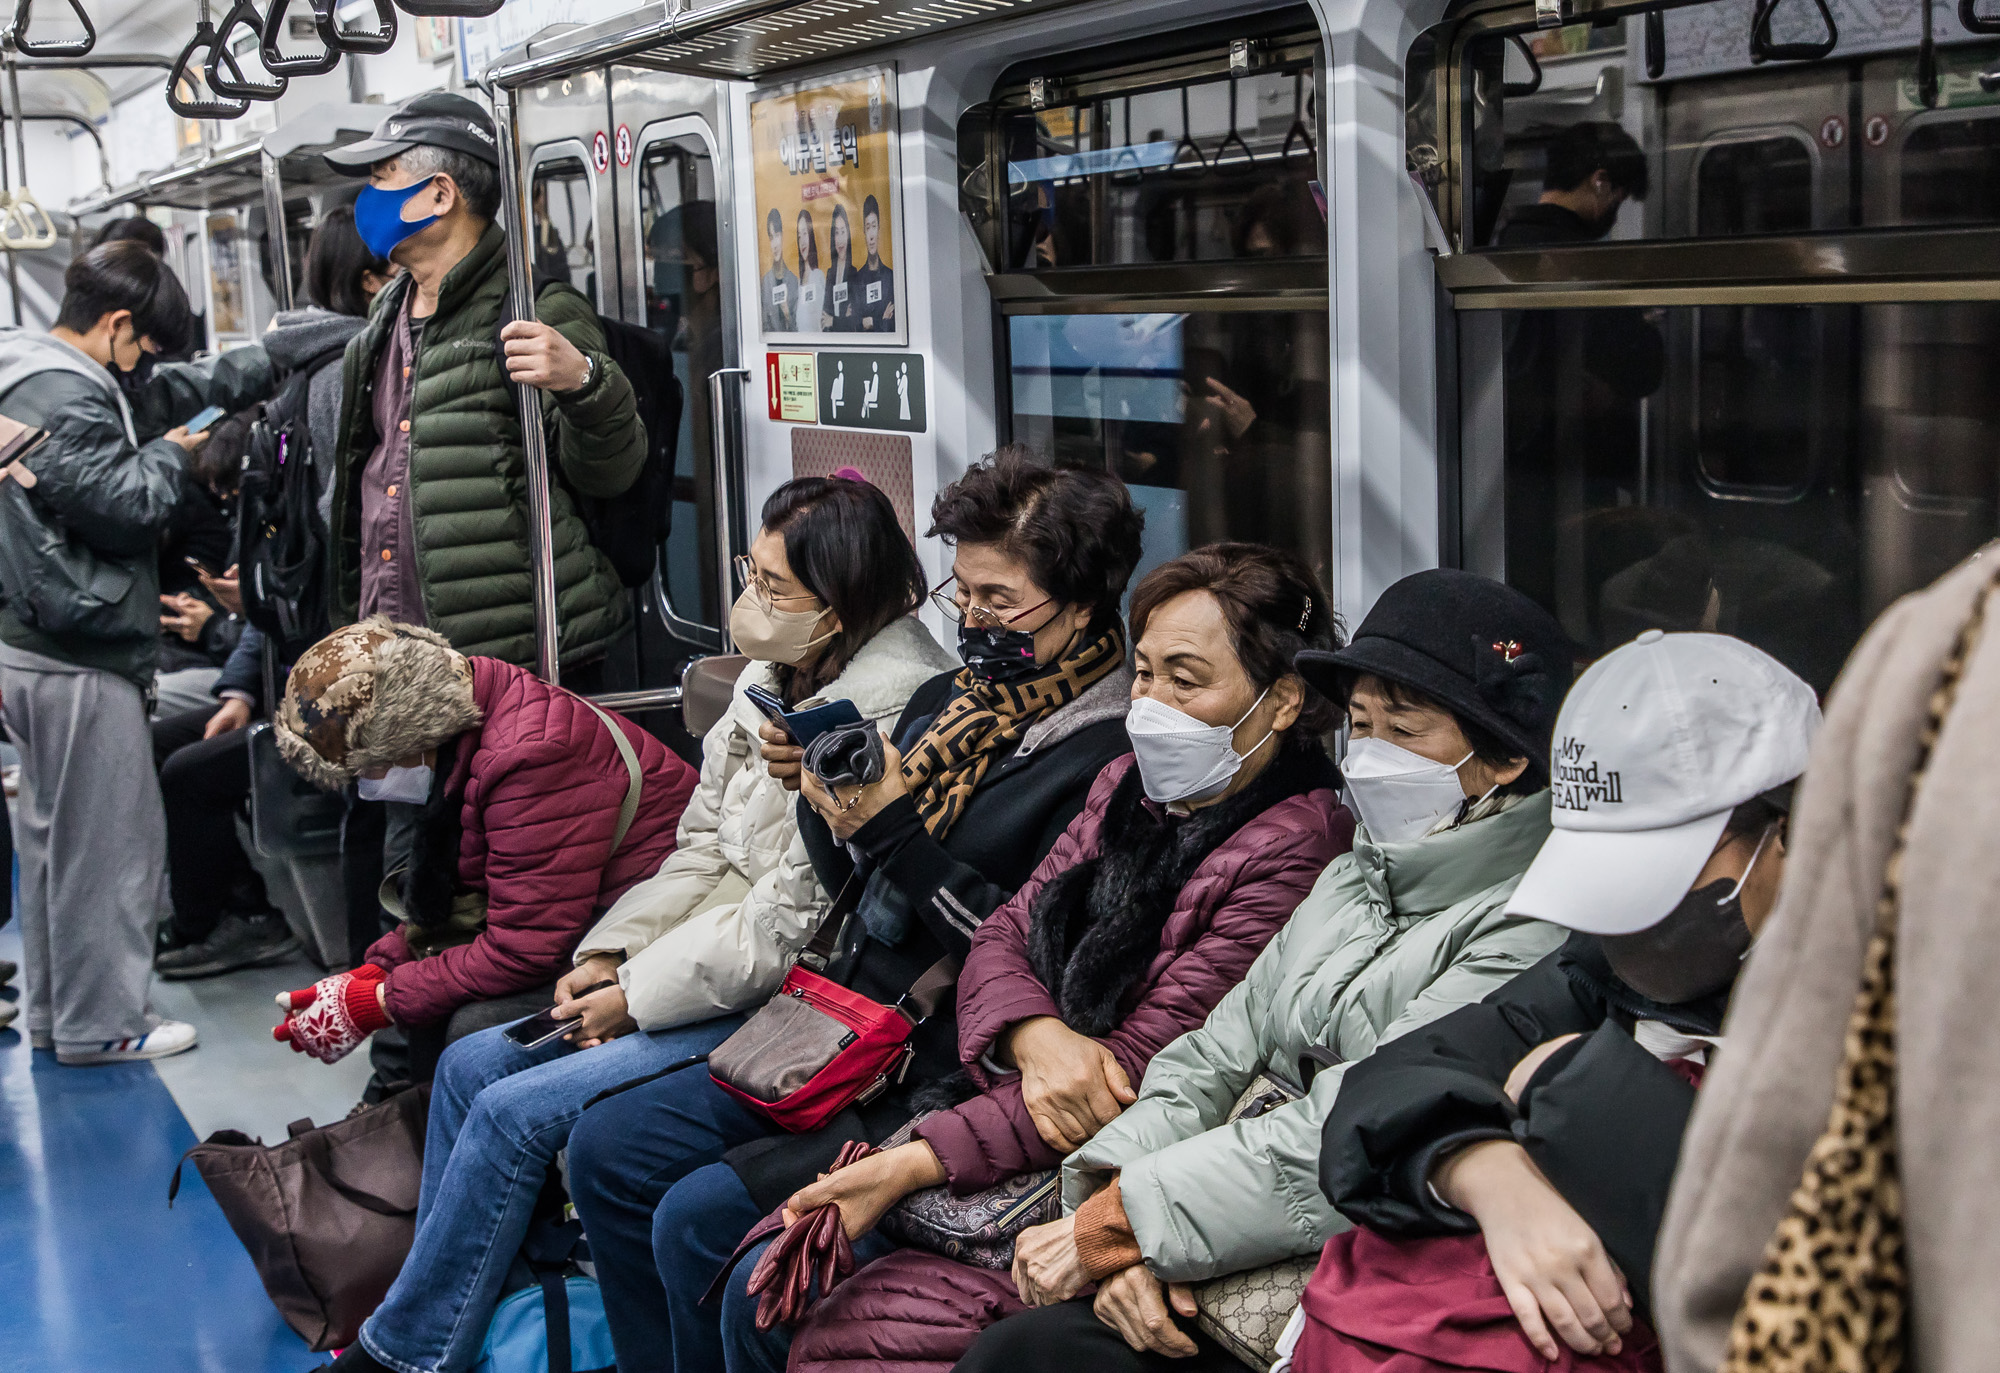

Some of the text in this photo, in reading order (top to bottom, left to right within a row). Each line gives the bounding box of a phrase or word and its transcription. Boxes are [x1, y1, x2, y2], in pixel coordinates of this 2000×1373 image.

[780, 123, 859, 175] 에듀윌 토익
[1561, 736, 1586, 765] My
[1552, 771, 1623, 811] EAL will
